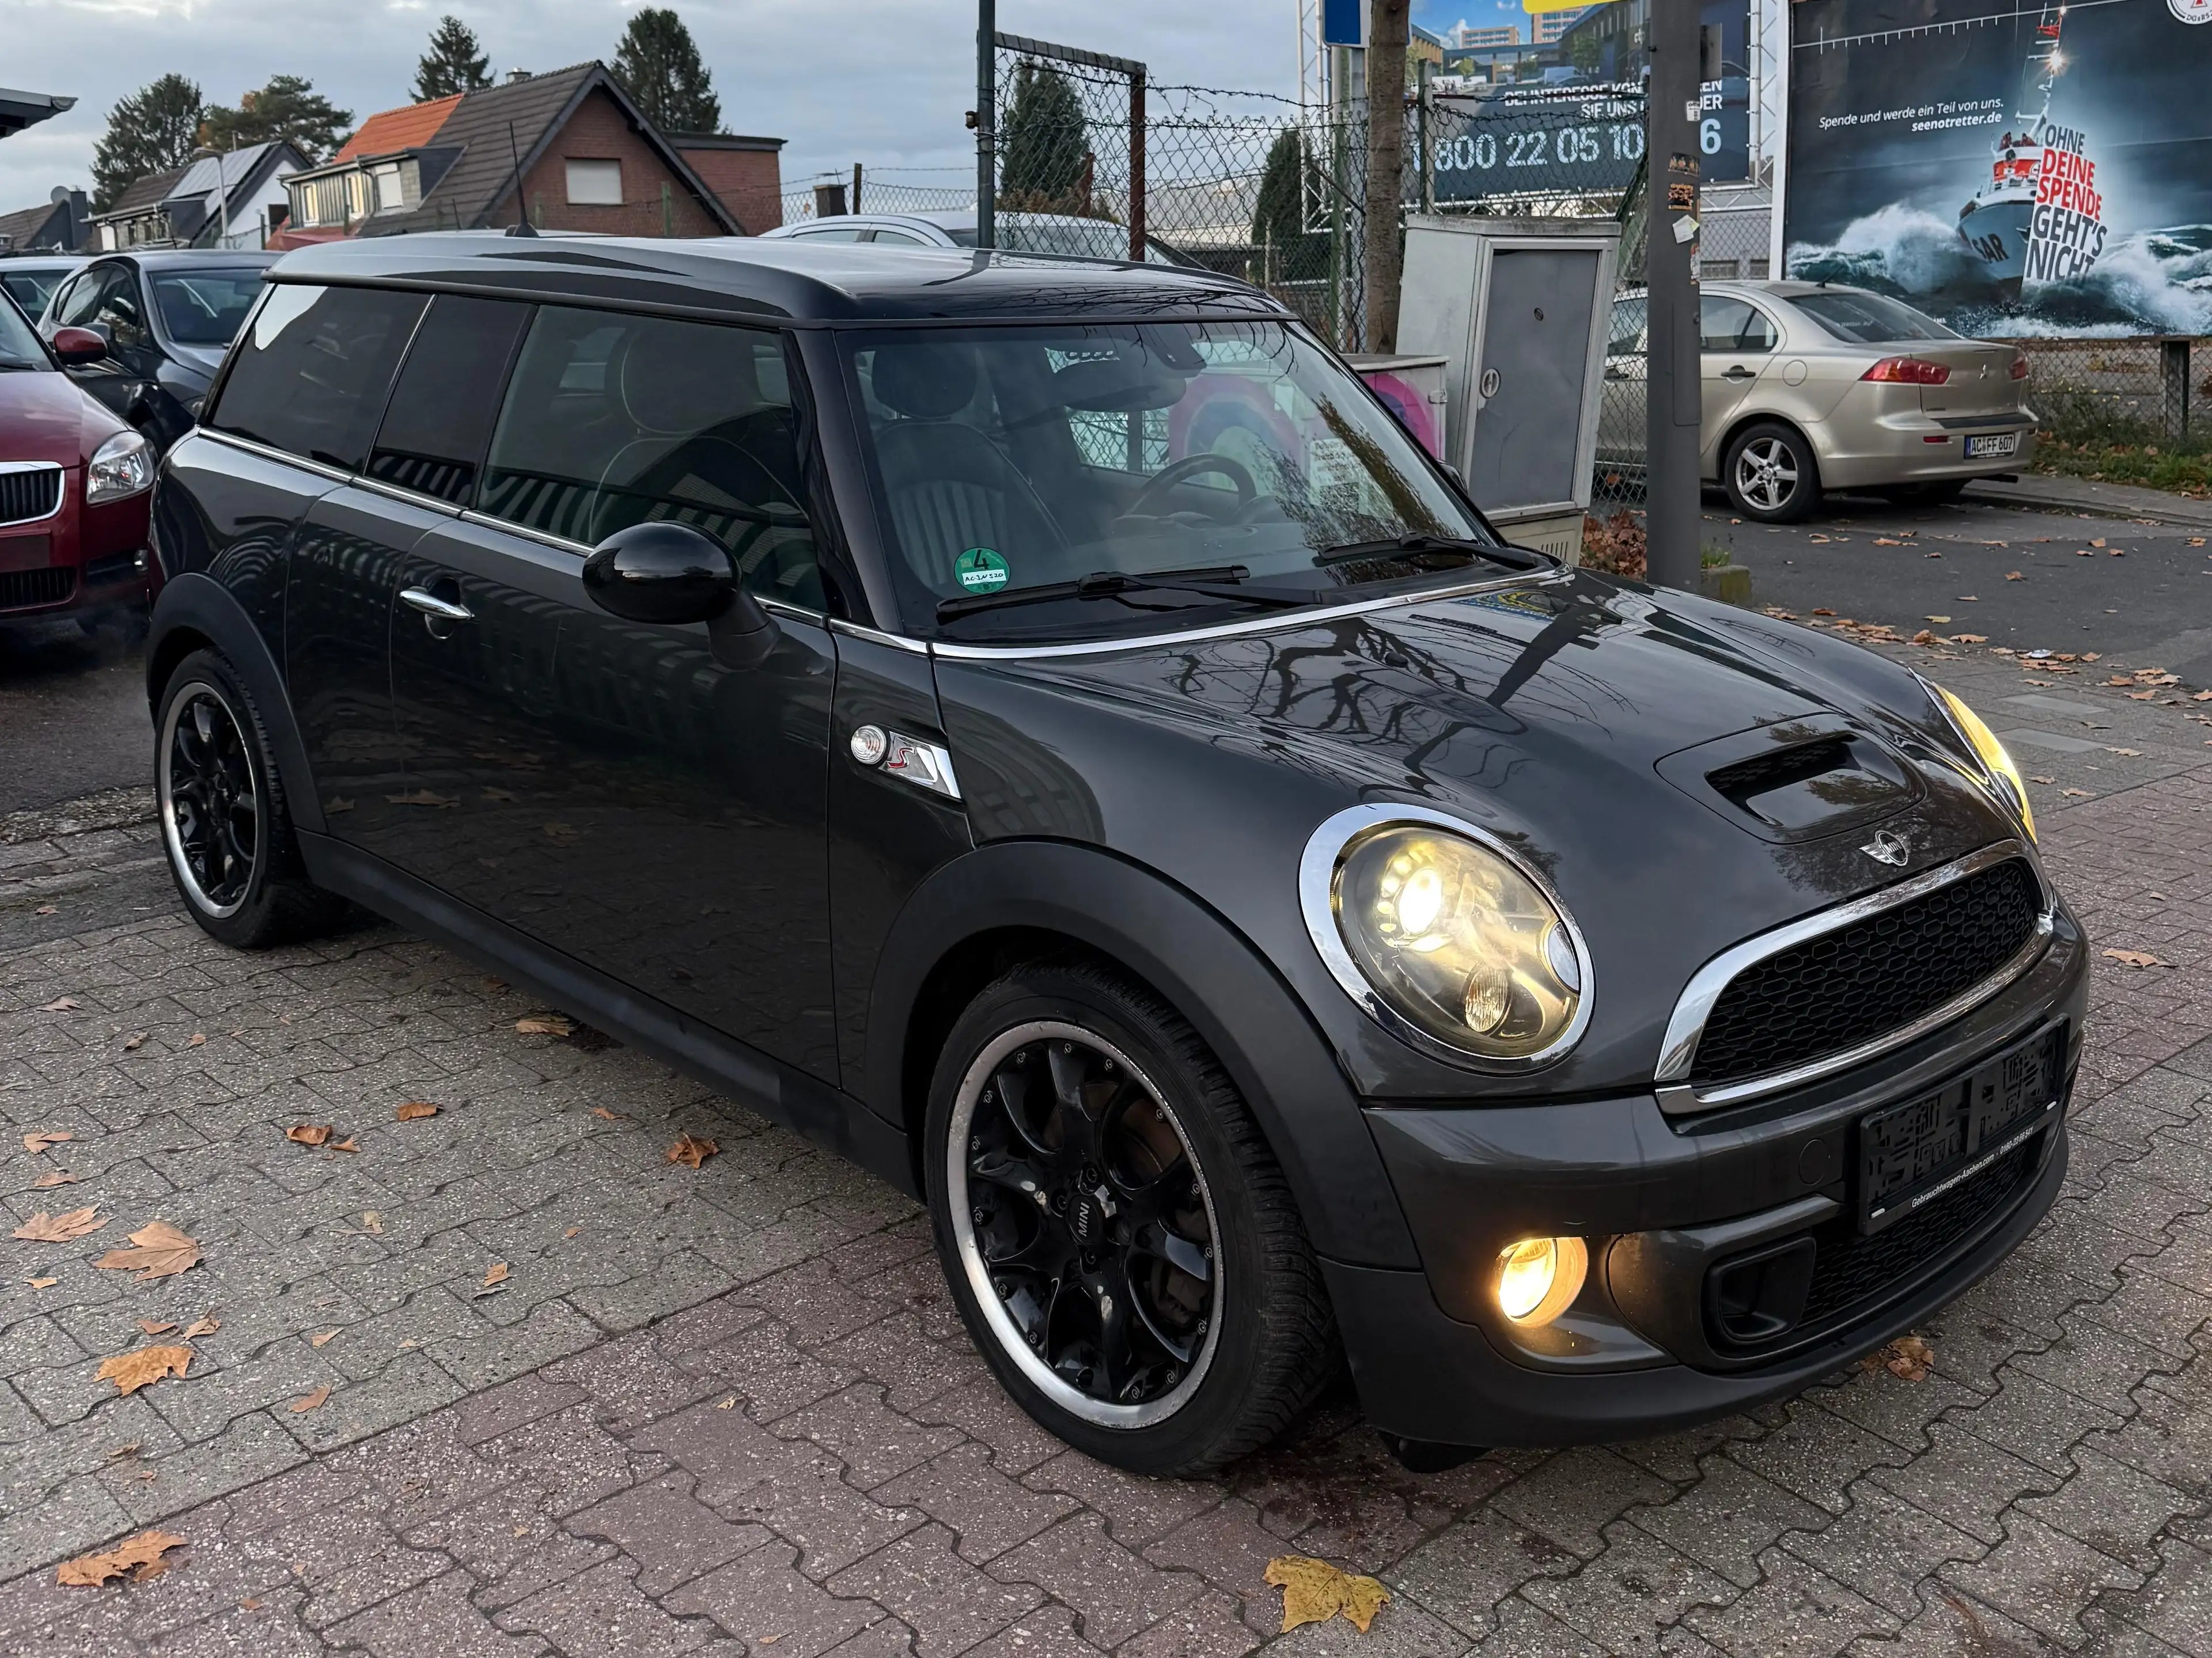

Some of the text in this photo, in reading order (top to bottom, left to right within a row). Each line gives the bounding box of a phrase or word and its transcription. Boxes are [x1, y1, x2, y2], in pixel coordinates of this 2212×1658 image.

[1530, 84, 1608, 104] INTERESSE
[1581, 102, 1604, 117] SIE
[1607, 101, 1638, 117] UNS
[1819, 98, 2004, 130] Spende und werde ein Teil von uns.
[1911, 111, 2002, 132] seenotretter.de
[1506, 131, 1548, 168] 22
[1557, 127, 1600, 164] 05
[1609, 123, 1644, 161] 10
[2045, 124, 2085, 155] OHNE
[2041, 148, 2096, 188] DEINE
[2036, 176, 2103, 221] SPENDE
[2033, 204, 2108, 257] GEHT'S
[1971, 233, 2010, 264] SAR
[2026, 238, 2096, 281] NICHT
[1971, 437, 2013, 453] AC FF 607
[974, 549, 989, 570] 4
[886, 746, 916, 768] S
[1078, 1202, 1089, 1237] MINI
